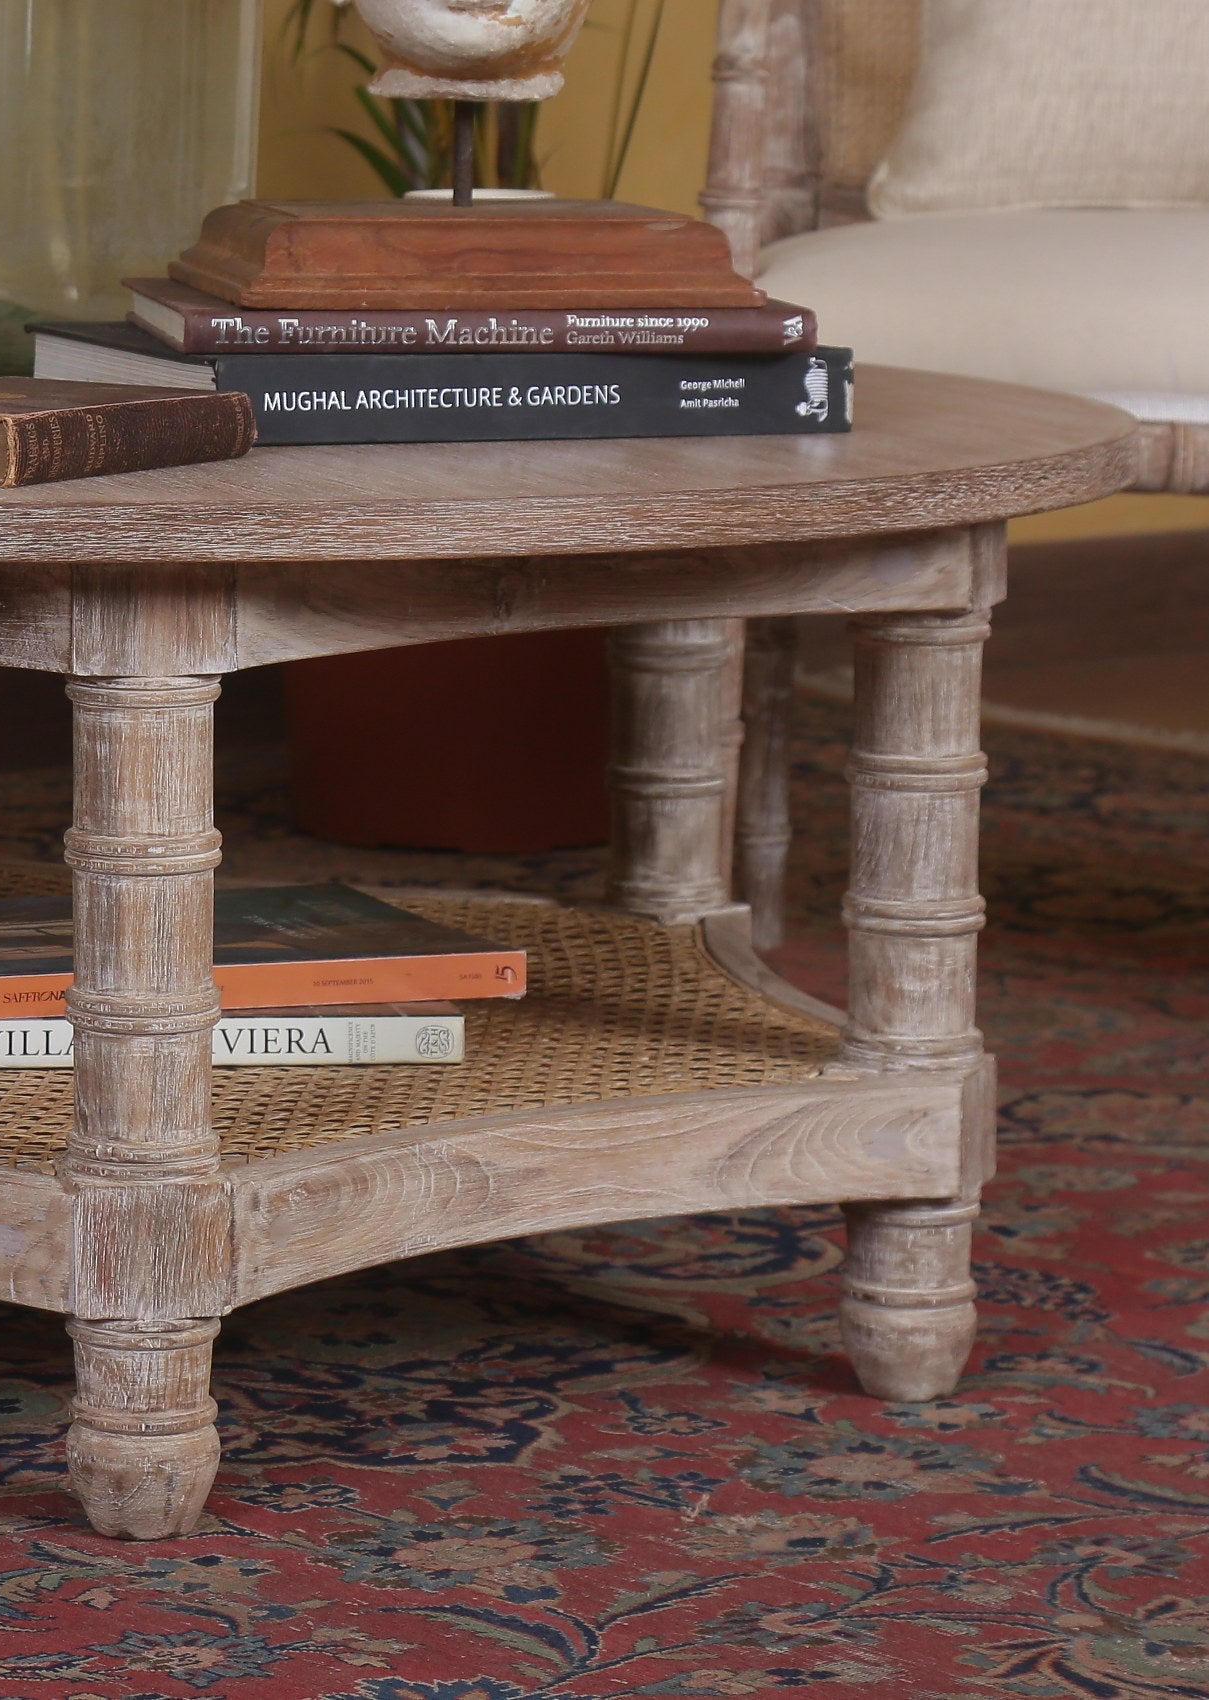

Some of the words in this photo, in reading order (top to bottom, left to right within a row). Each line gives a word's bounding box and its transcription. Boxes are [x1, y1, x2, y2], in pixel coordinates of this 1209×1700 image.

[212, 317, 270, 345] The
[278, 317, 417, 345] Furniture
[425, 317, 554, 345] Machine
[566, 314, 635, 328] Furniture
[638, 314, 674, 328] since
[677, 316, 710, 333] 1990
[566, 331, 615, 345] Gareth
[619, 330, 685, 345] Williams
[680, 379, 712, 392] George
[713, 378, 745, 390] Michell
[264, 390, 352, 412] MUGHAL
[355, 386, 503, 410] ARCHITECTURE
[508, 386, 523, 408] &
[527, 384, 621, 407] GARDENS
[680, 397, 702, 409] Amit
[703, 397, 740, 408] Pasricha
[212, 1027, 334, 1055] VIERA
